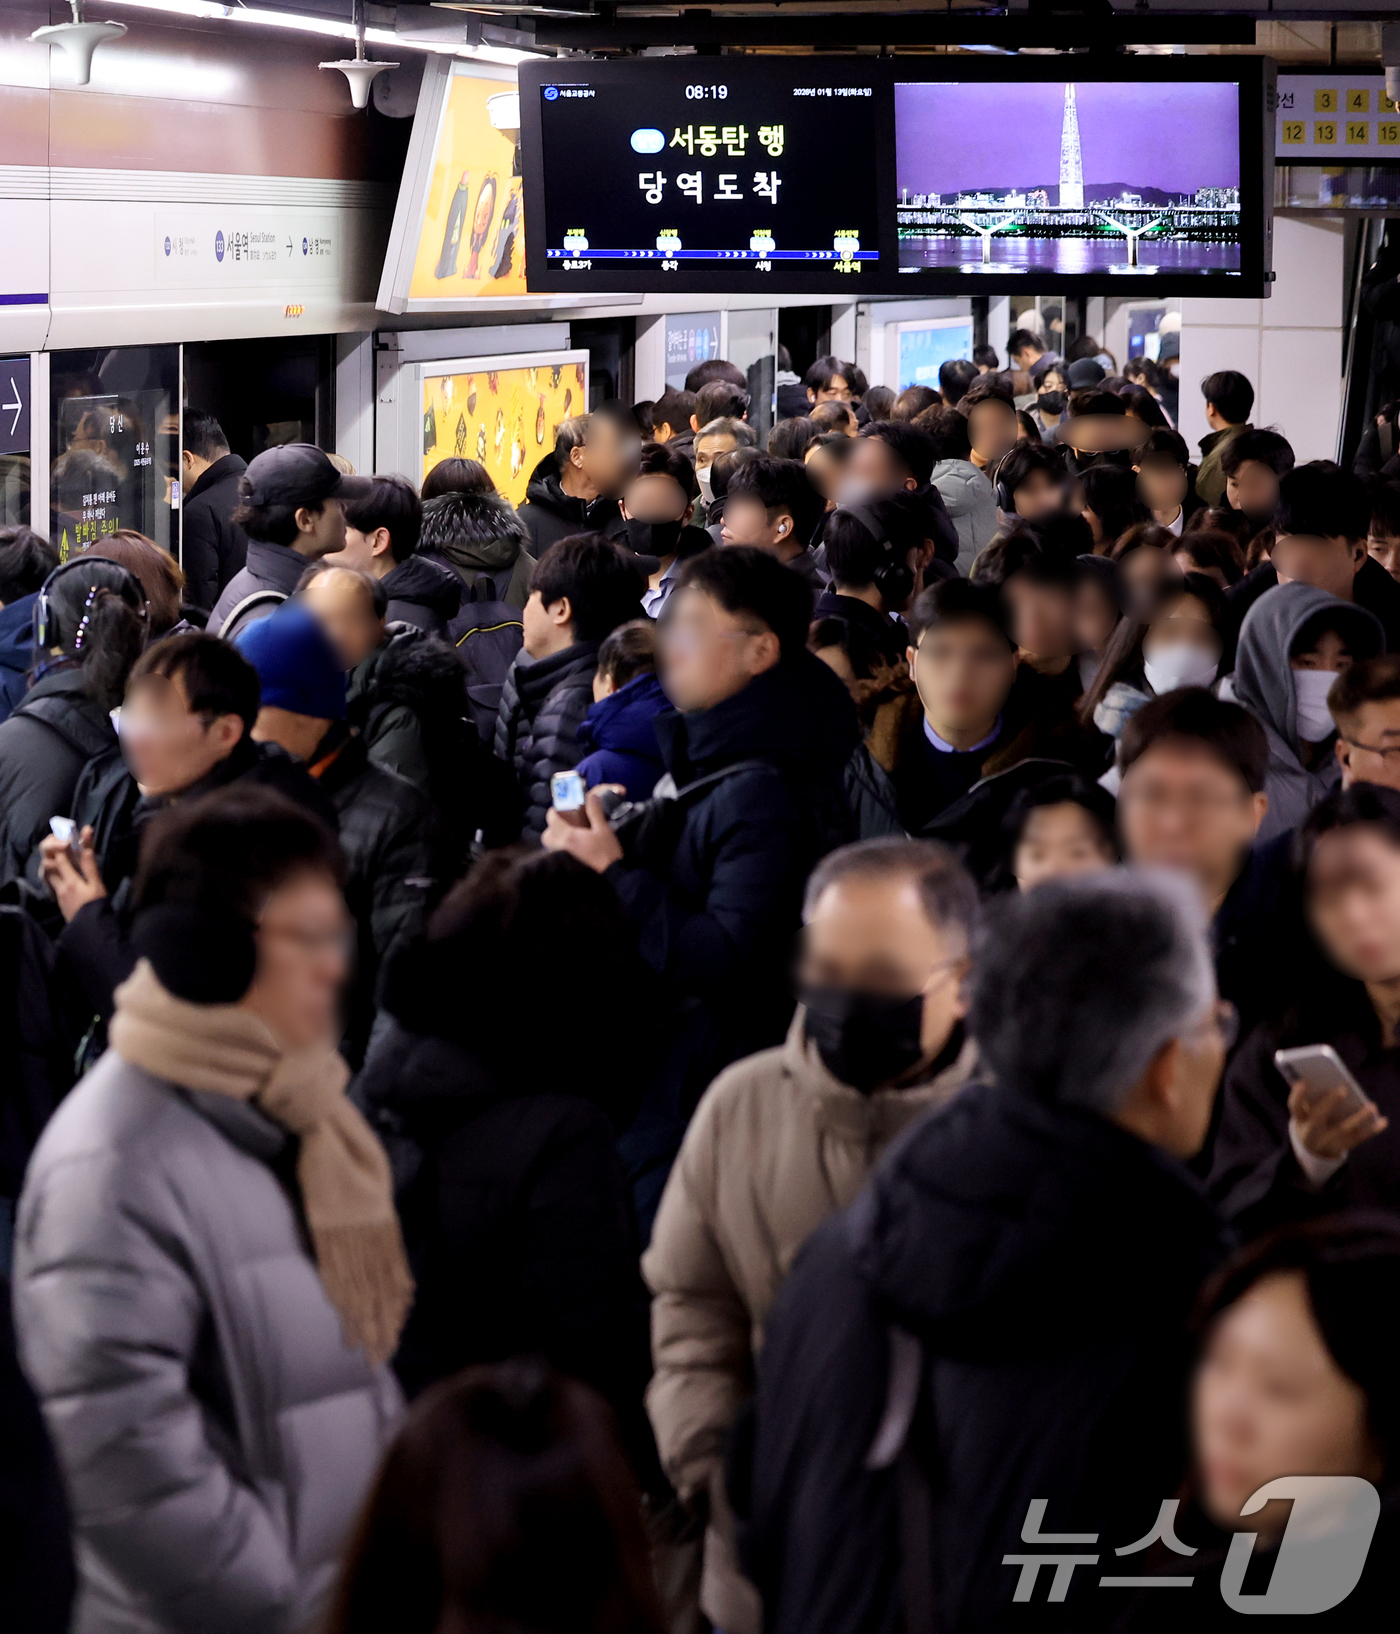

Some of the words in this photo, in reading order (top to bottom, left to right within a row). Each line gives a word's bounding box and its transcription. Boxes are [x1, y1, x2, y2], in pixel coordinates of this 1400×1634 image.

[560, 89, 596, 98] 서울교통공사
[685, 84, 728, 100] 08:19
[817, 88, 832, 97] 01월
[1276, 92, 1294, 109] 선
[1321, 94, 1330, 107] 3
[1353, 95, 1362, 107] 4
[1286, 125, 1302, 140] 12
[1317, 125, 1334, 140] 13
[1349, 126, 1366, 140] 14
[1381, 126, 1398, 141] 15
[669, 125, 749, 156] 서동탄
[757, 125, 784, 156] 행
[250, 231, 261, 243] Seoul
[261, 231, 276, 243] Station
[215, 240, 224, 253] 133
[227, 231, 249, 261] 서울역
[562, 259, 592, 271] 종로3가
[661, 260, 678, 271] 종각
[755, 260, 772, 272] 시청
[833, 260, 861, 273] 서울역
[75, 521, 97, 543] 발빠짐
[101, 517, 119, 535] 주의!
